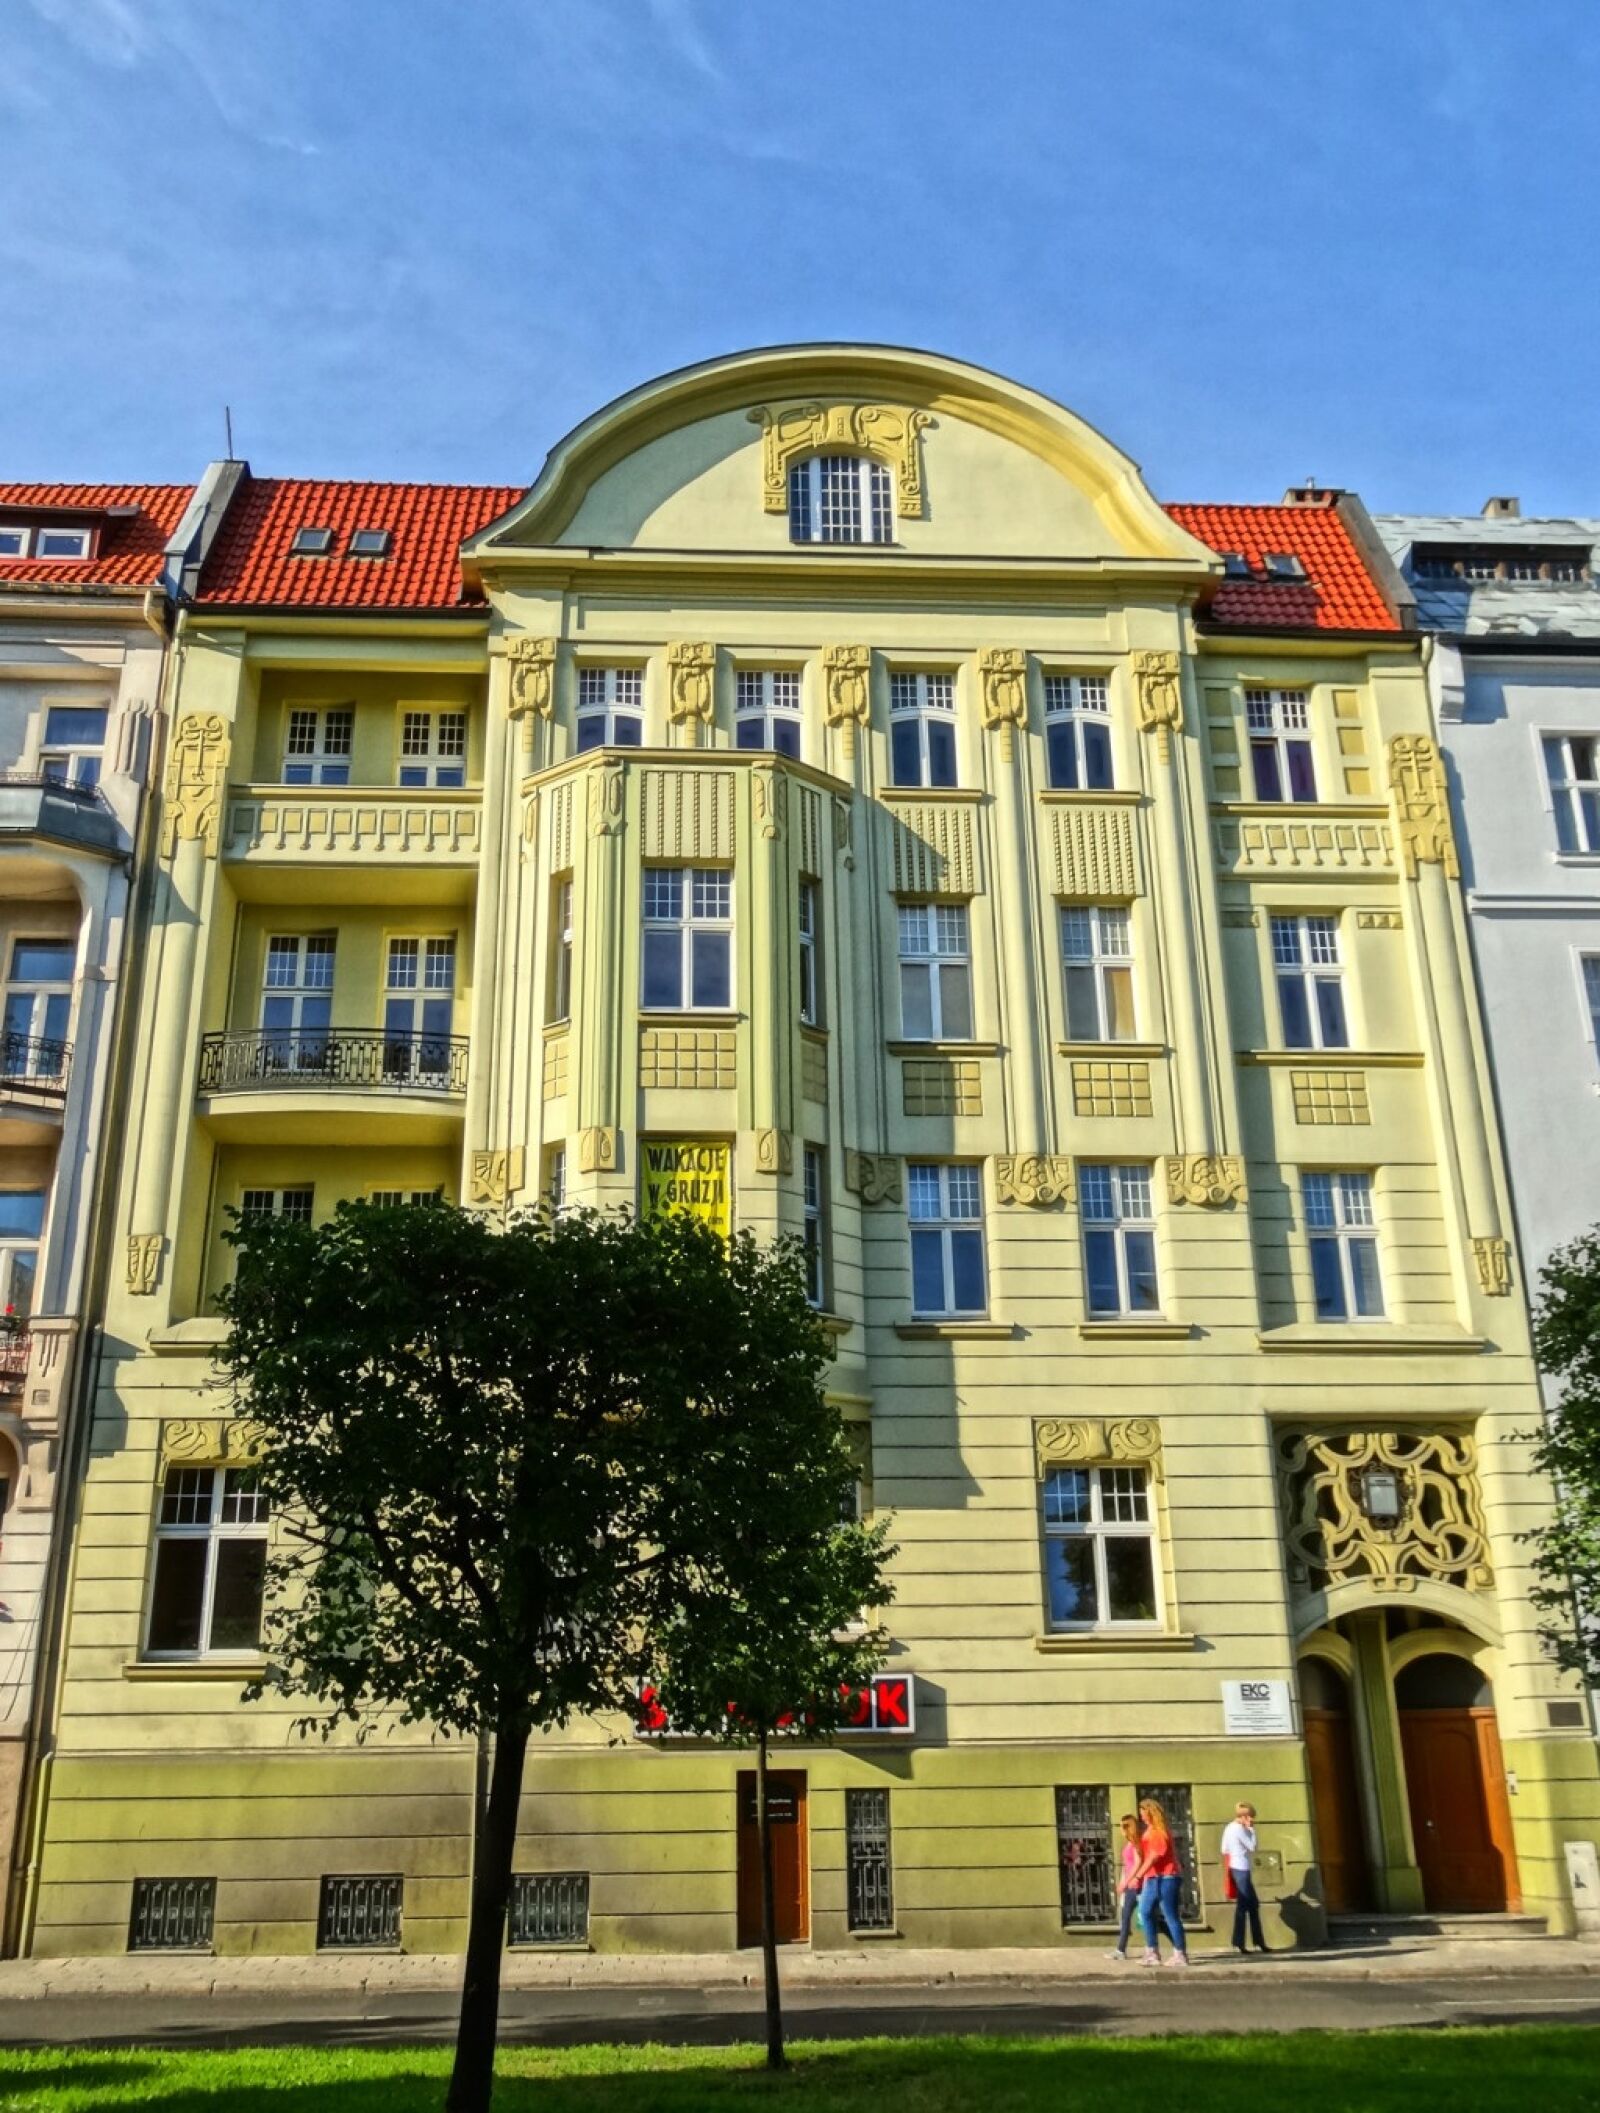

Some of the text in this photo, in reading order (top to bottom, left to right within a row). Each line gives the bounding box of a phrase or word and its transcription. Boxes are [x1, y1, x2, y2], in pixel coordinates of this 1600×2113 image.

[647, 1148, 725, 1174] WAKACJE
[667, 1180, 724, 1206] GRUZJI
[1240, 1683, 1270, 1697] EKC
